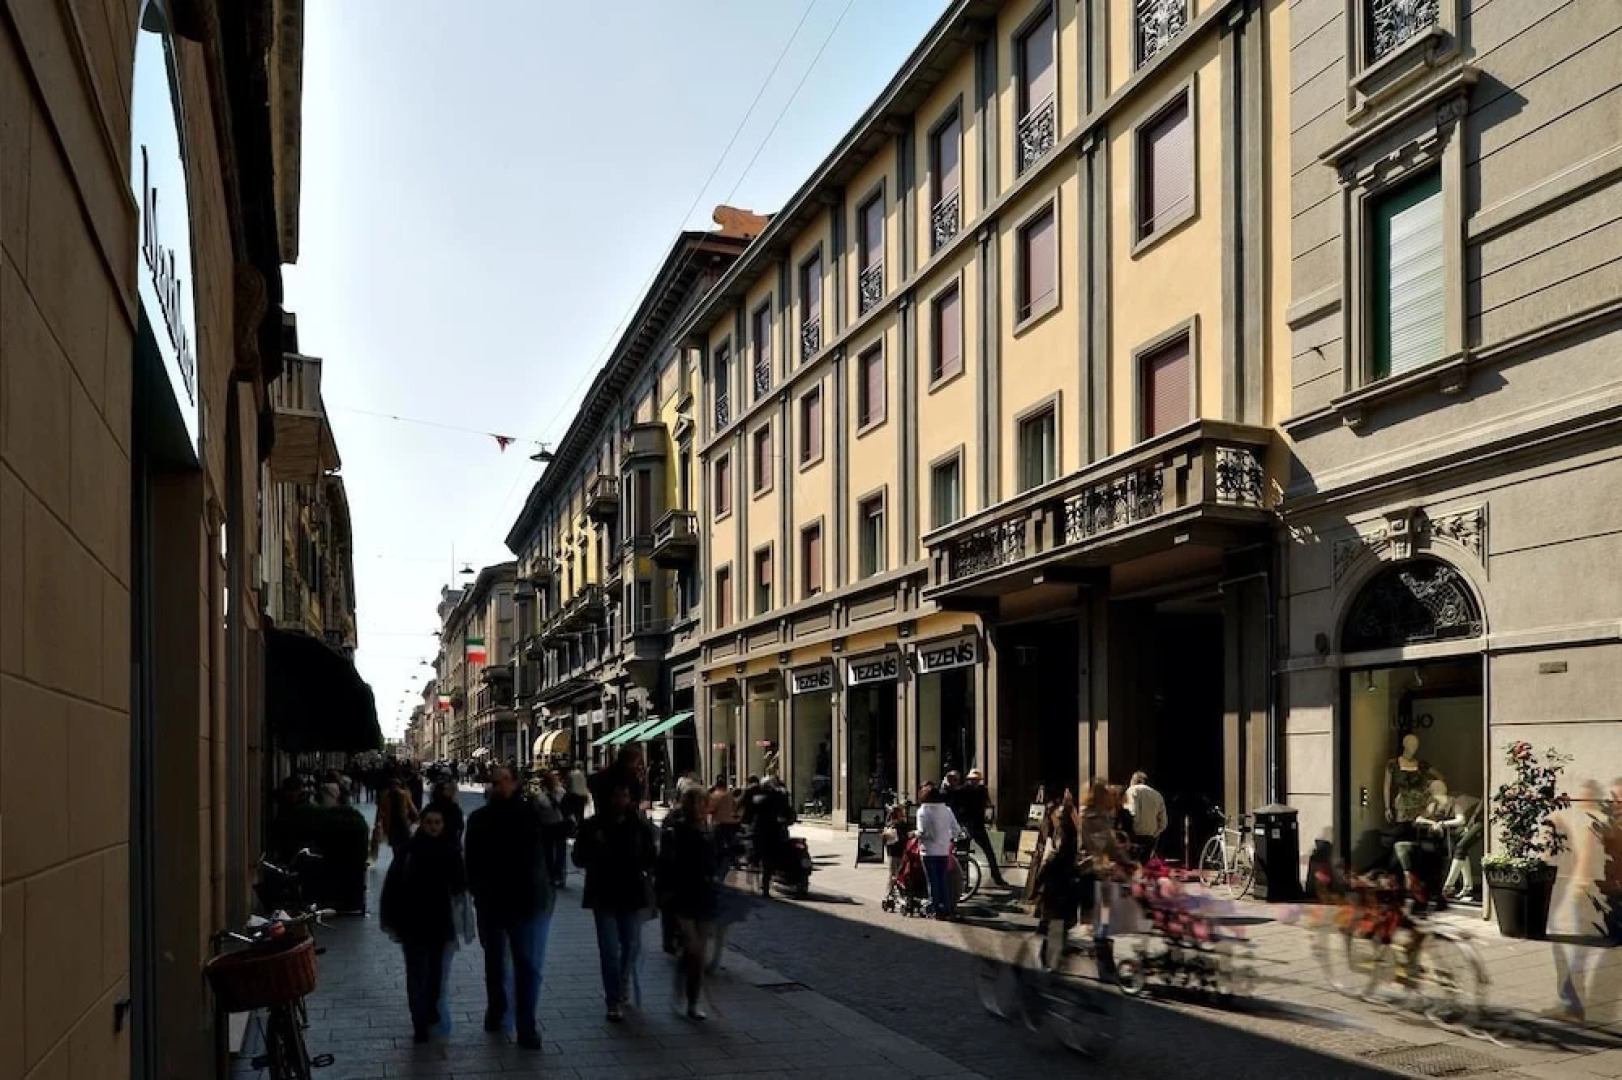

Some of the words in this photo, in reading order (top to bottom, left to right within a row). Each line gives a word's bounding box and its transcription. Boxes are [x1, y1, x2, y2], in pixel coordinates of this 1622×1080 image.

[923, 640, 974, 669] TEZENIS
[795, 668, 830, 691] TEZENIS
[852, 655, 896, 681] TEZENIS
